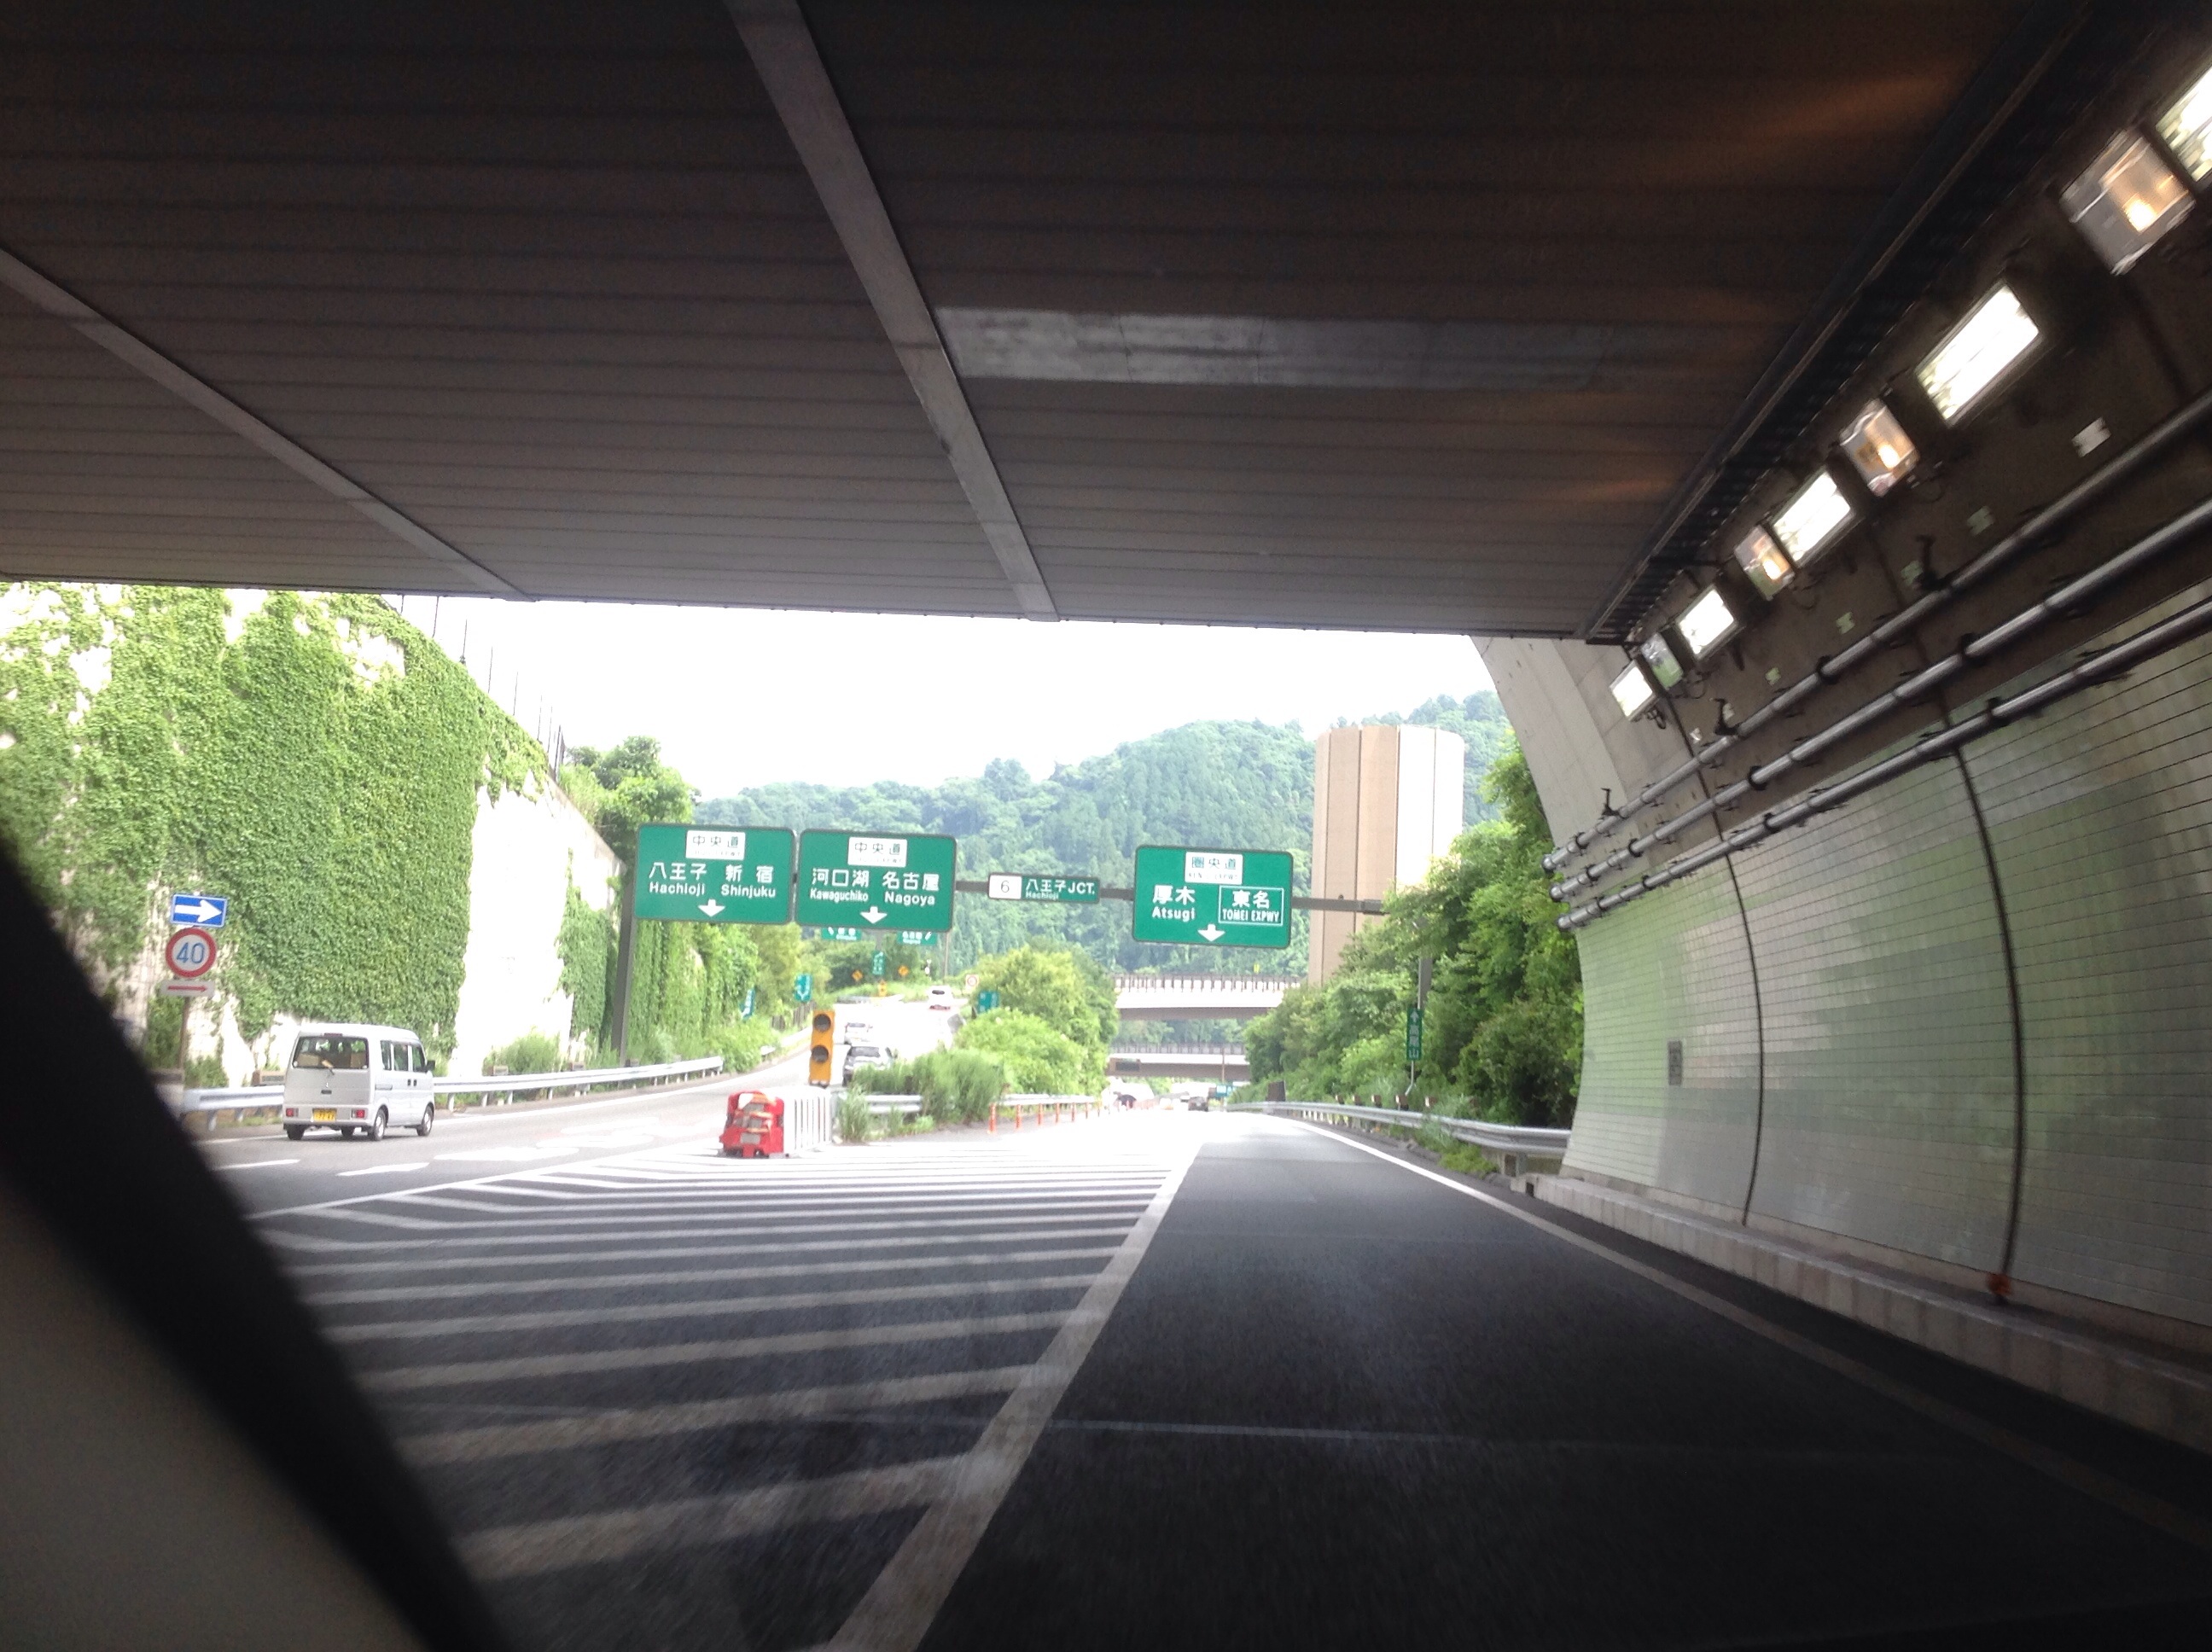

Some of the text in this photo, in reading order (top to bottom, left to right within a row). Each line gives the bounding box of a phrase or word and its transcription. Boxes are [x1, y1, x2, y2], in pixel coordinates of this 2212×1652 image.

[692, 835, 739, 849] 中央道
[854, 841, 900, 856] 中央道
[649, 862, 707, 881] 八王子
[812, 868, 940, 892] 河口湖 名古屋
[649, 881, 777, 899] Hachioji Shinjuku
[1000, 880, 1010, 893] 6
[1152, 884, 1196, 906] 厚木
[810, 887, 936, 907] Kawaguchiko Nagoya
[1231, 889, 1271, 910] 東名
[1152, 905, 1195, 923] Atsugi
[1221, 908, 1280, 923] TOMEI EXPWY
[176, 942, 206, 964] 40
